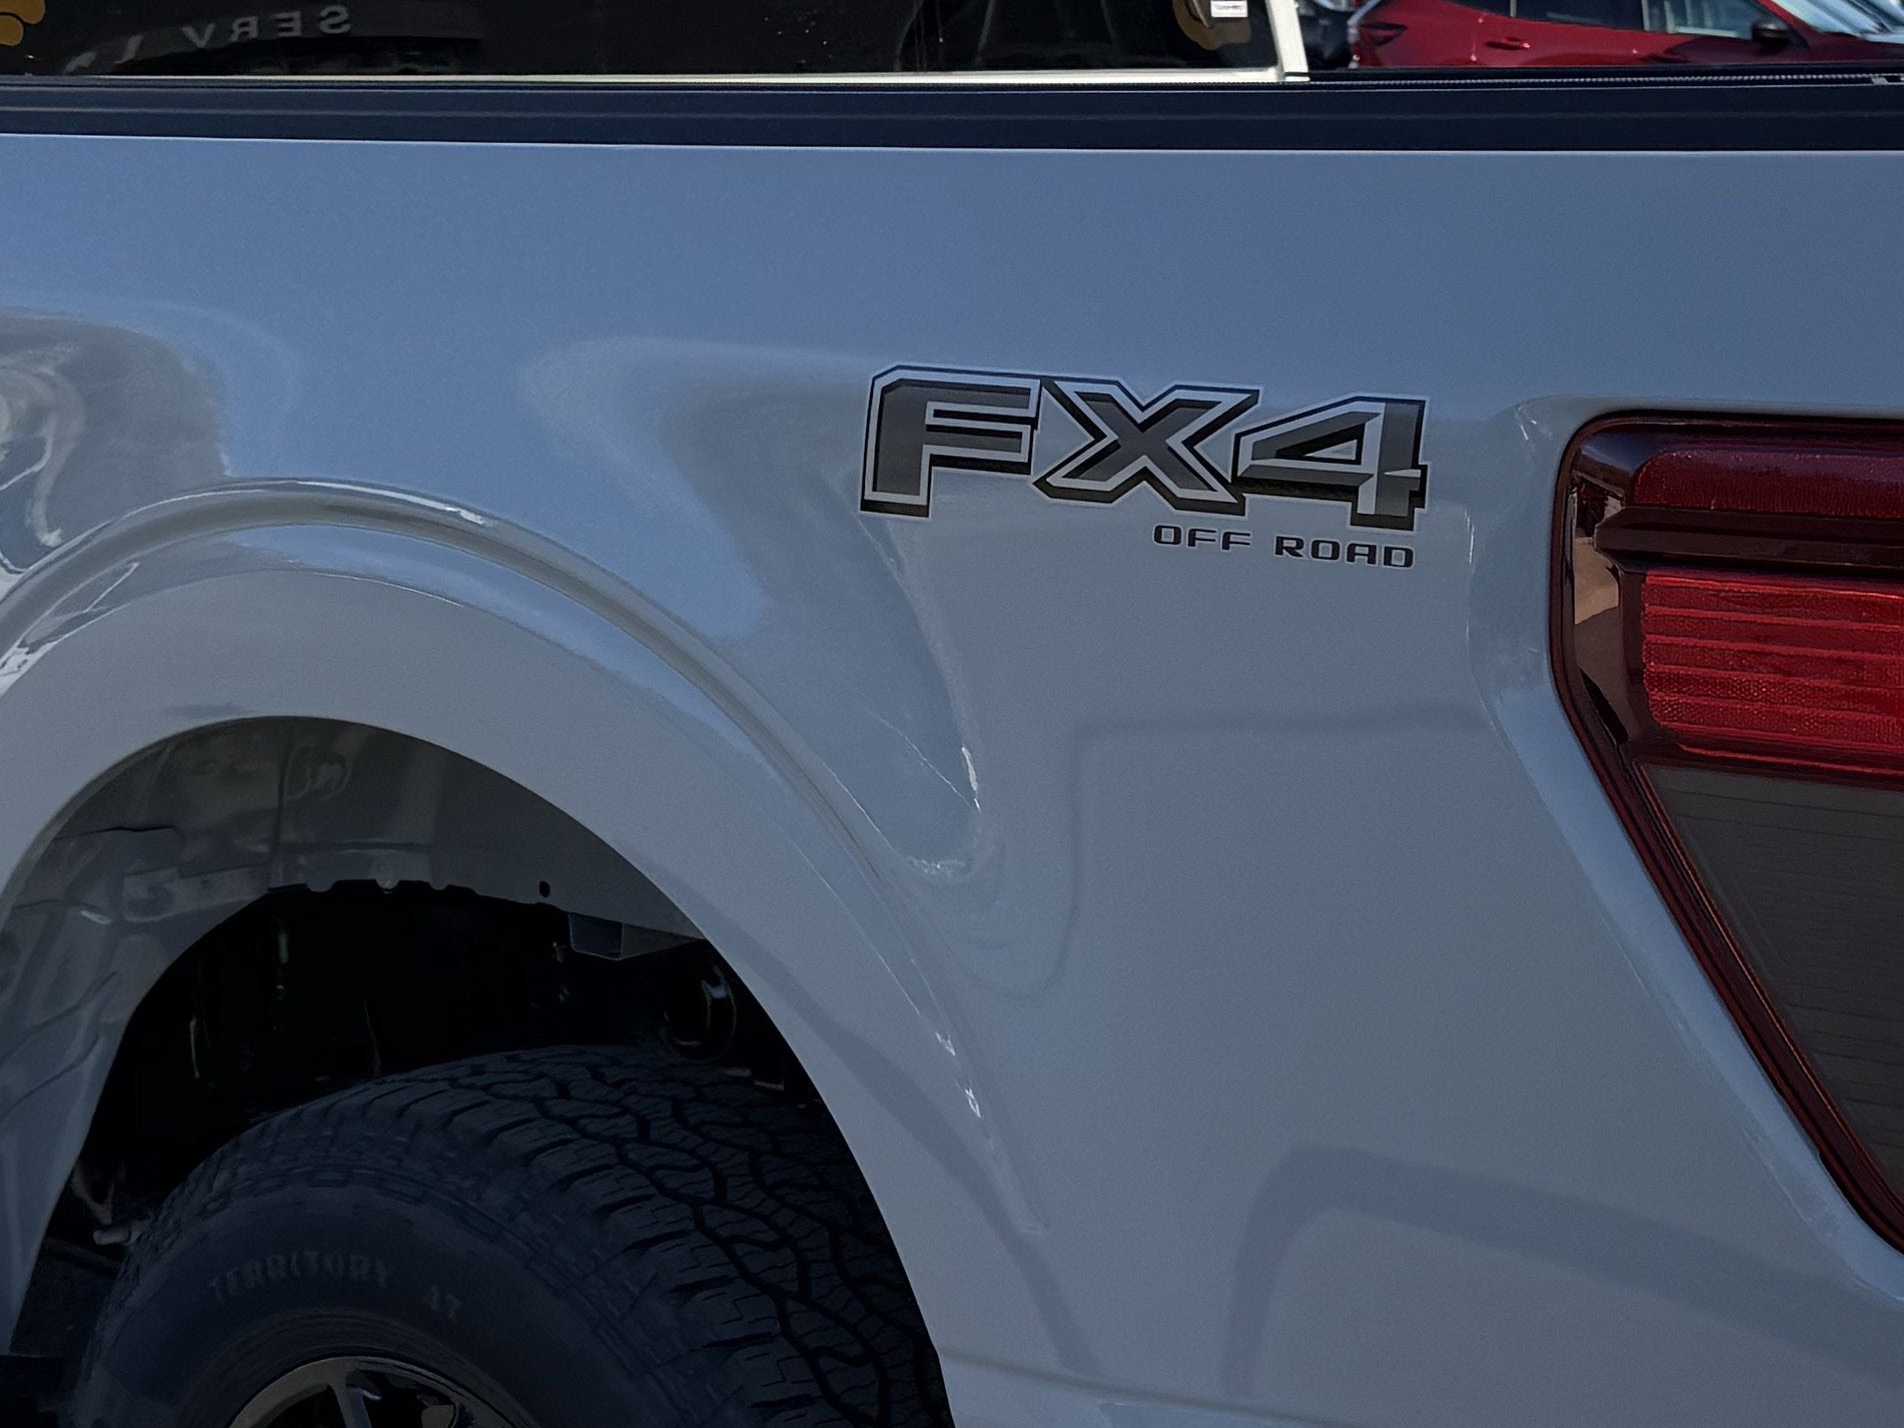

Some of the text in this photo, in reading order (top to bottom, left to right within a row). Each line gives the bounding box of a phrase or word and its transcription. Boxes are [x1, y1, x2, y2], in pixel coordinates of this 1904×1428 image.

[859, 364, 1429, 532] FX4
[1153, 524, 1415, 569] OFF ROAD
